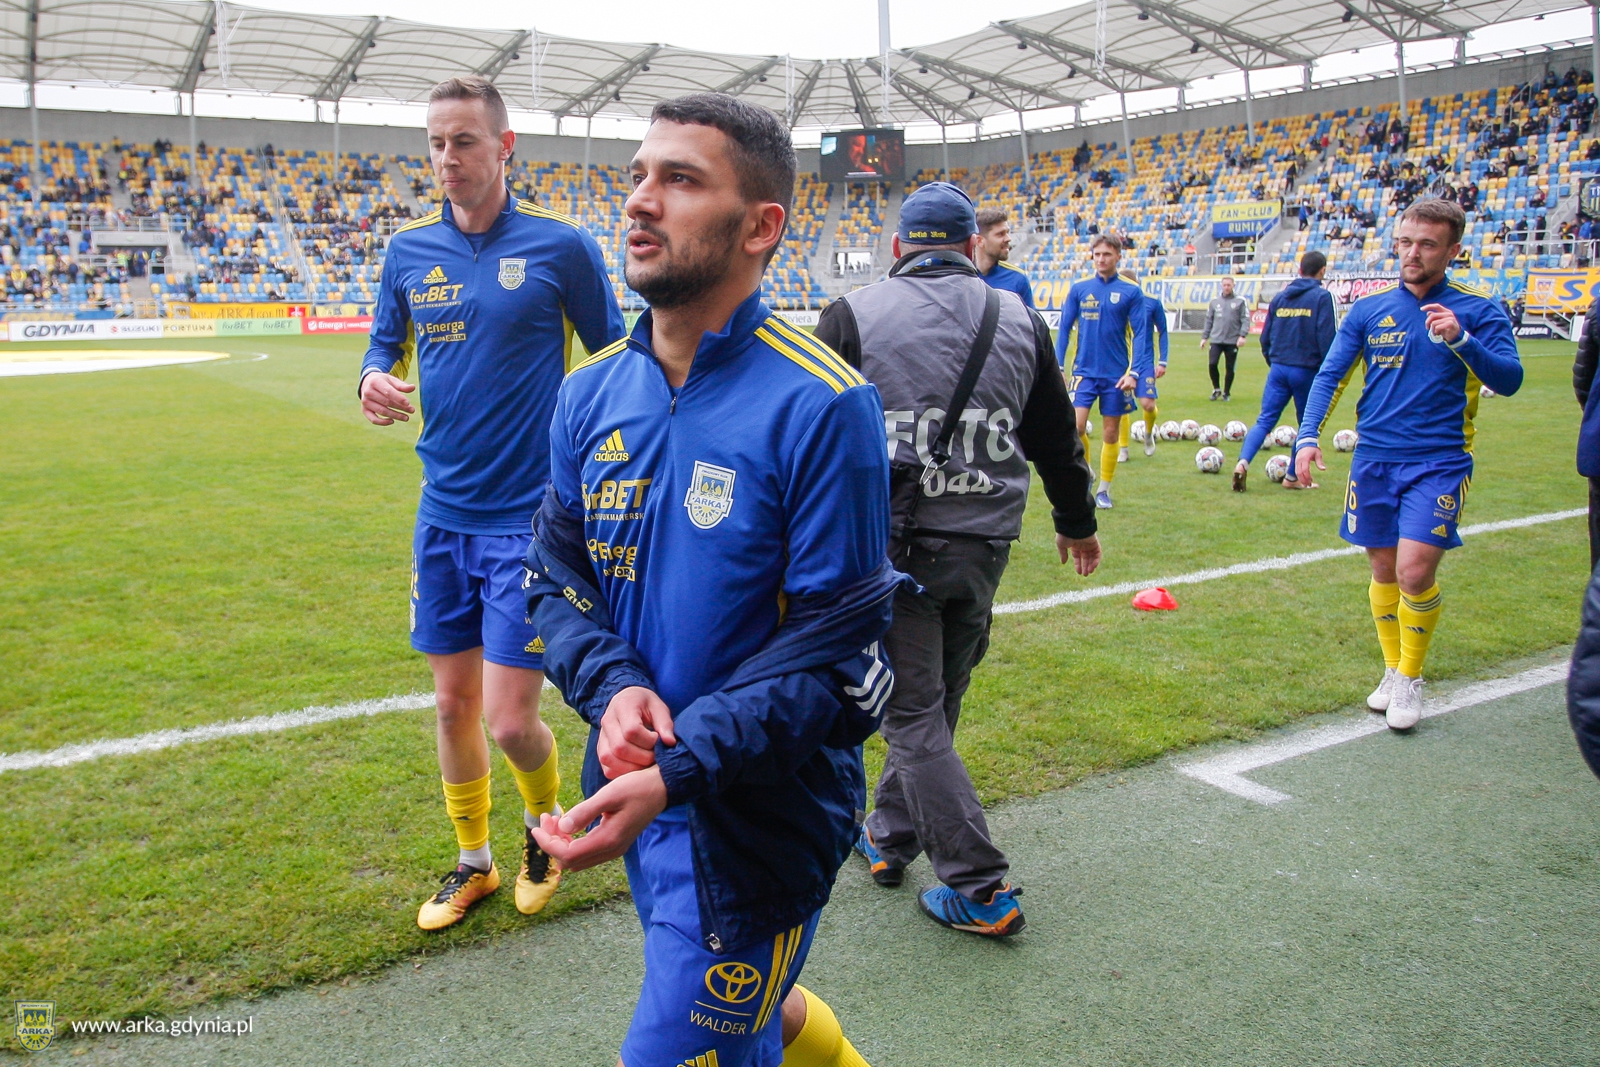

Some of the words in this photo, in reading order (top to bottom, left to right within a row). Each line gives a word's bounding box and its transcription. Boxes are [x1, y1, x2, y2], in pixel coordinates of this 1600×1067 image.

[1228, 222, 1262, 234] RUMIA
[409, 284, 464, 305] forBET
[23, 324, 95, 338] GDYNIA
[426, 321, 465, 334] Energa
[1367, 331, 1407, 345] forBET
[884, 407, 1015, 468] FOTO
[594, 450, 629, 462] adidas
[923, 469, 994, 498] 044
[695, 497, 722, 509] ARKA
[690, 1010, 746, 1035] WALDER
